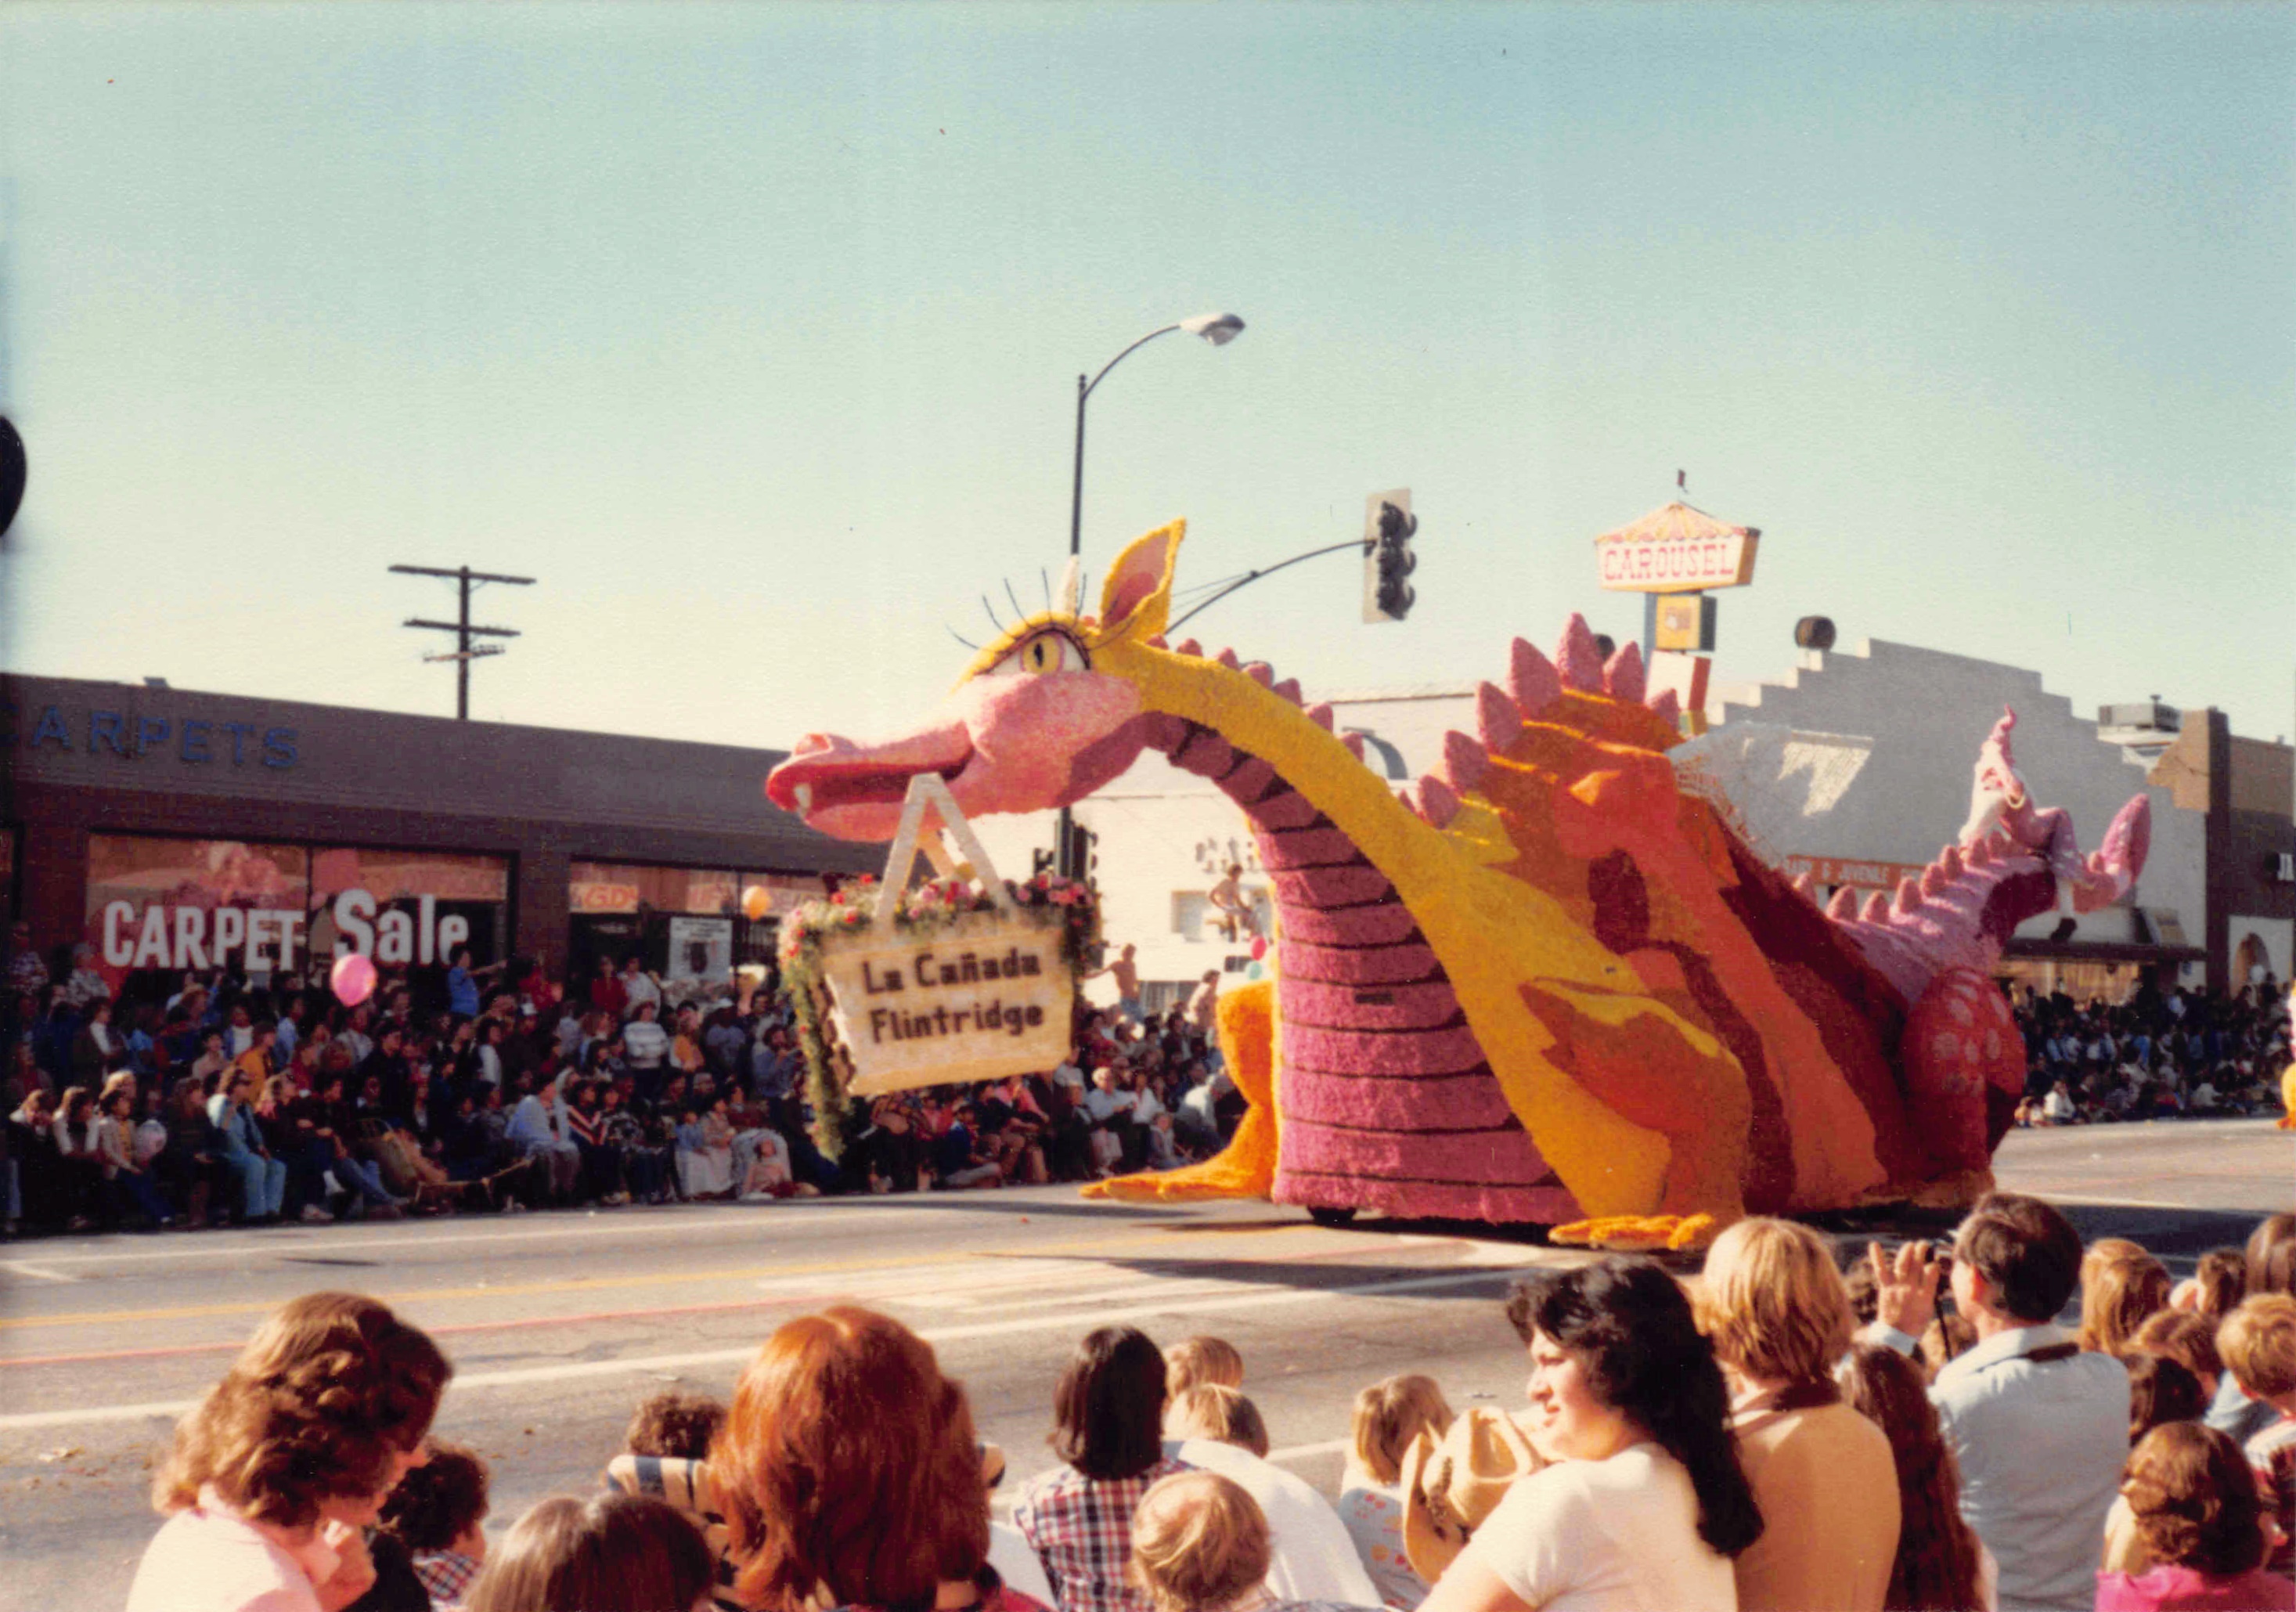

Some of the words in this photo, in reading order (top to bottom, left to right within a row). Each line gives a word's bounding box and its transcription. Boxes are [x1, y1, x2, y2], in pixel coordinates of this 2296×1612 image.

[1605, 544, 1734, 580] CAROUSEL
[103, 900, 306, 972] CARPET
[333, 888, 469, 965] Sale
[863, 961, 903, 994] La
[915, 947, 1040, 987] Cañada
[870, 998, 1043, 1044] Flintridge
